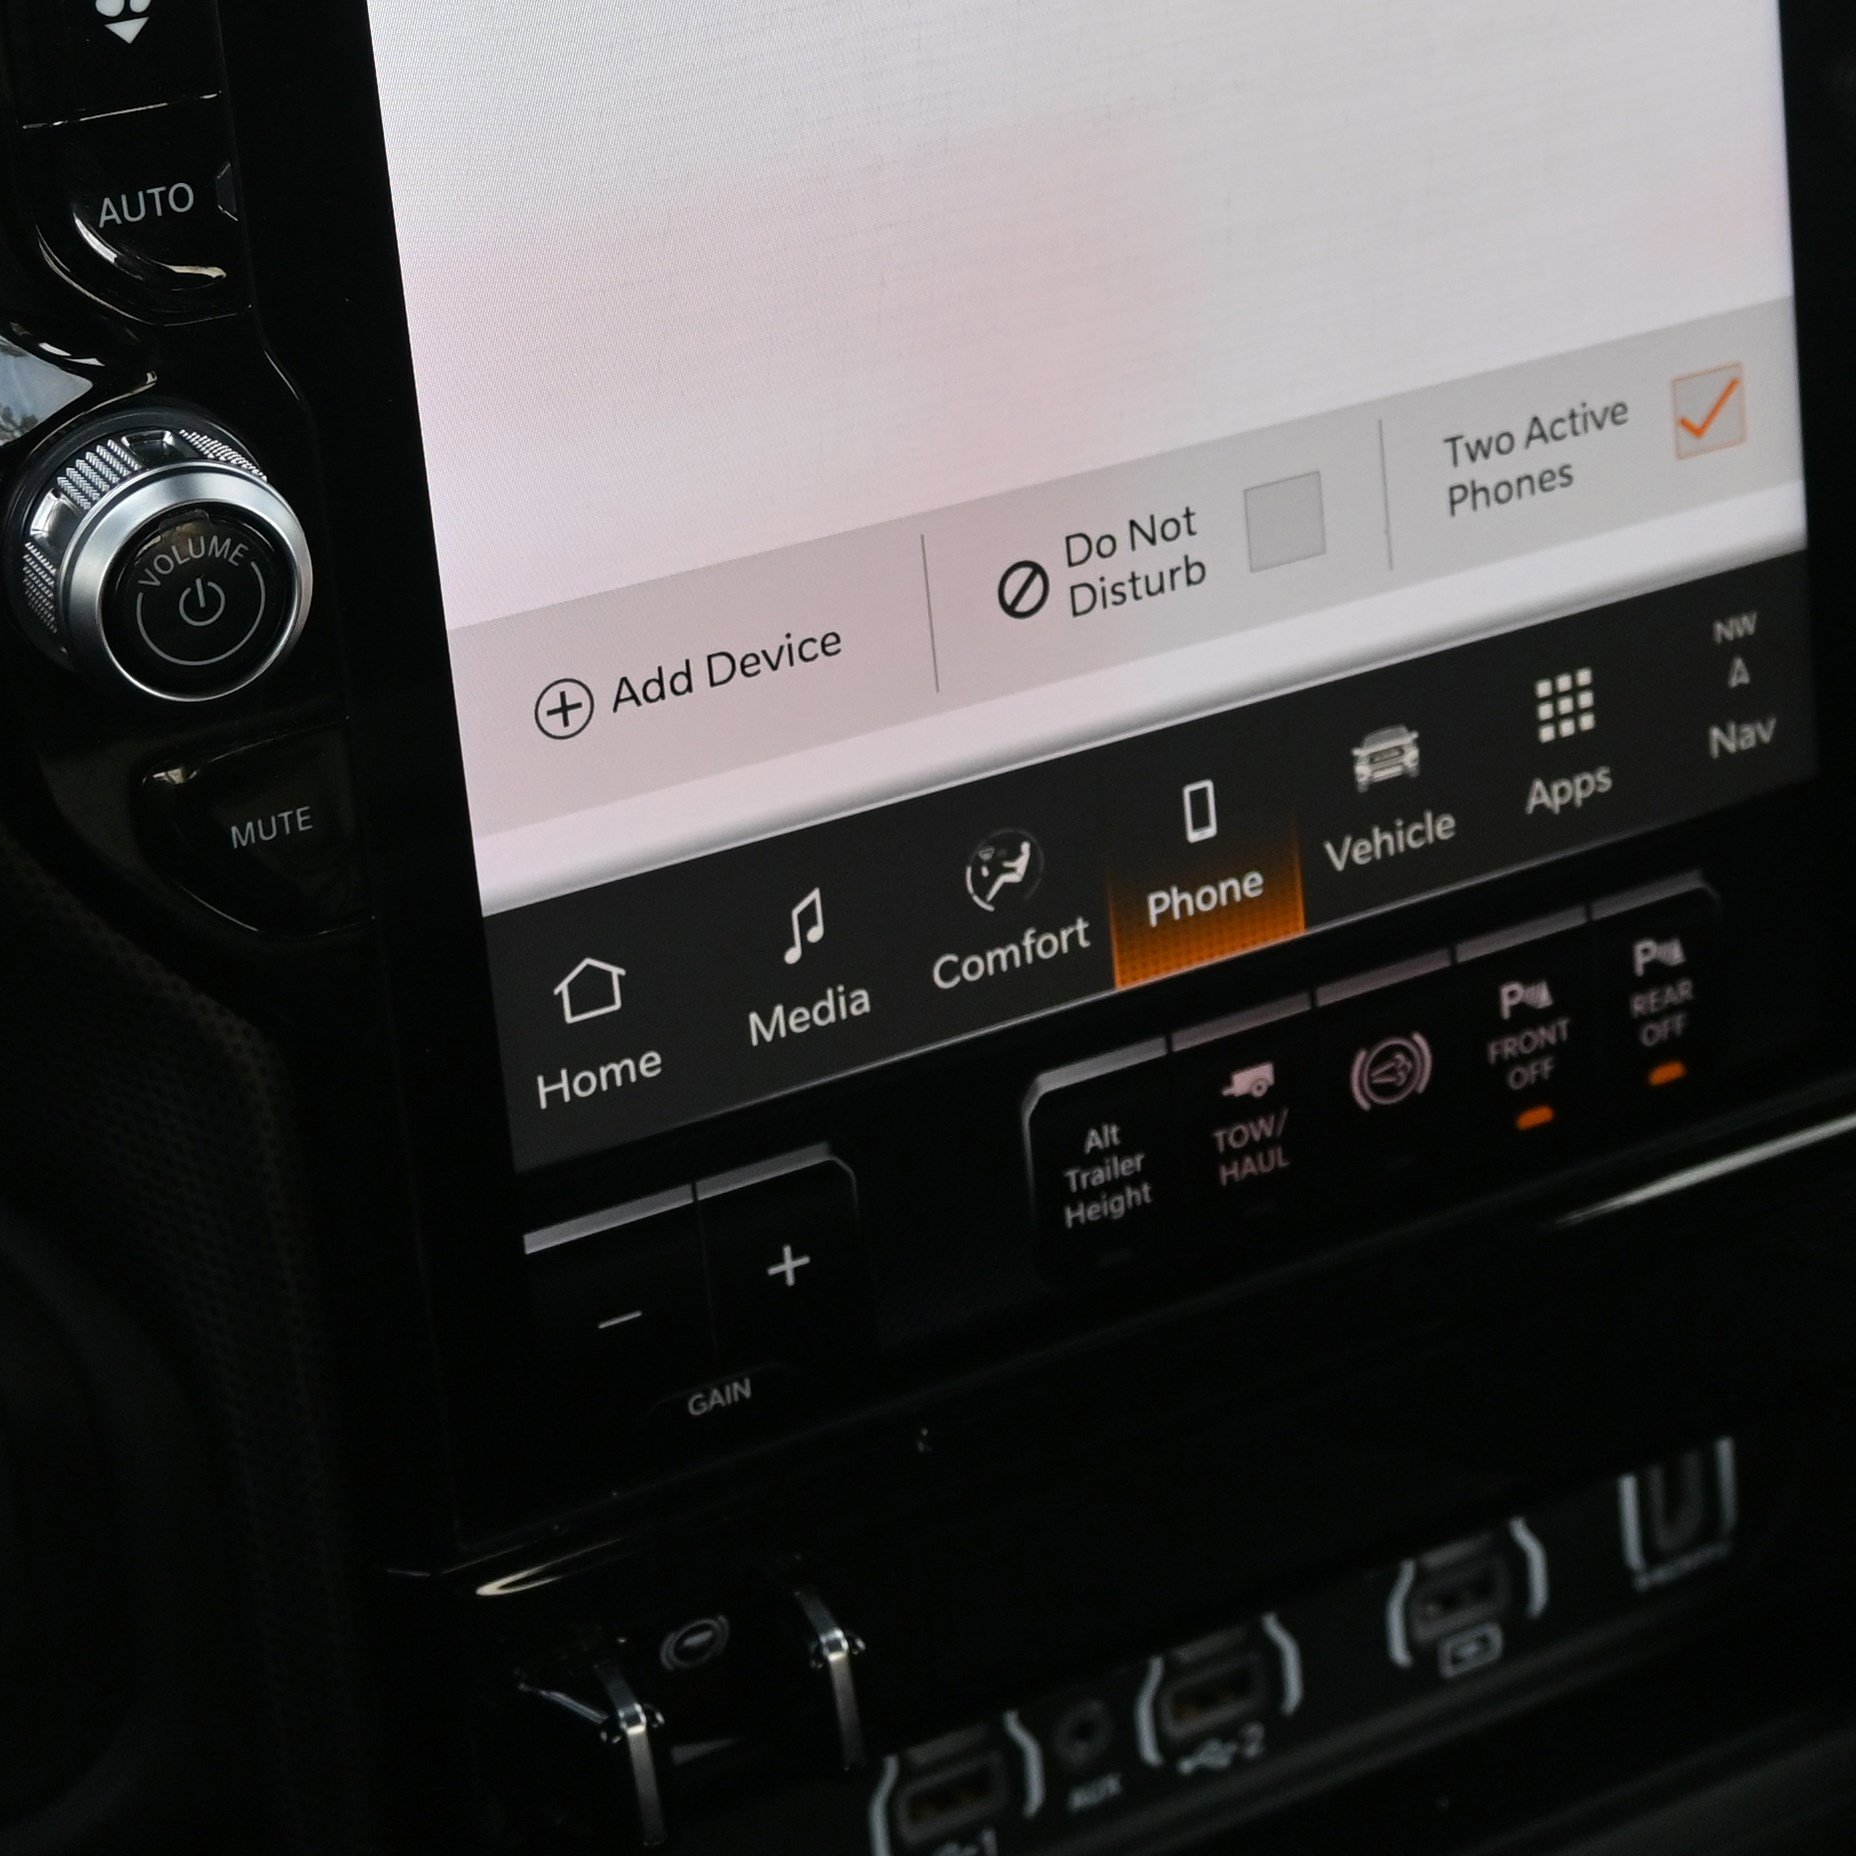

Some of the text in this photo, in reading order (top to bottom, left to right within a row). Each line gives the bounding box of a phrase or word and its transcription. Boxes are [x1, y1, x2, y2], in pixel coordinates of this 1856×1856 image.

[97, 180, 196, 230] AUTO
[1443, 395, 1630, 470] Two Active
[1447, 459, 1575, 518] Phones
[138, 534, 250, 591] VOLUME
[1065, 505, 1198, 568] Do Not
[1068, 554, 1208, 619] Disturb
[1712, 611, 1759, 647] NW
[611, 630, 843, 714] Add Device
[1707, 715, 1778, 761] Nav
[1525, 765, 1614, 817] Apps
[230, 805, 315, 850] MUTE
[1323, 808, 1457, 874] Vehicle
[1145, 866, 1266, 929] Phone
[931, 914, 1092, 992] Comfort
[747, 984, 872, 1047] Media
[1629, 976, 1694, 1020] REAR
[1486, 1017, 1572, 1067] FRONT
[1639, 1009, 1689, 1048] OFF
[536, 1047, 664, 1111] Home
[1505, 1054, 1557, 1093] OFF
[1082, 1120, 1122, 1156] Alt
[1063, 1150, 1147, 1196] Trailer
[1217, 1144, 1291, 1188] HAUL
[1062, 1179, 1154, 1231] Height
[686, 1377, 753, 1418] GAIN
